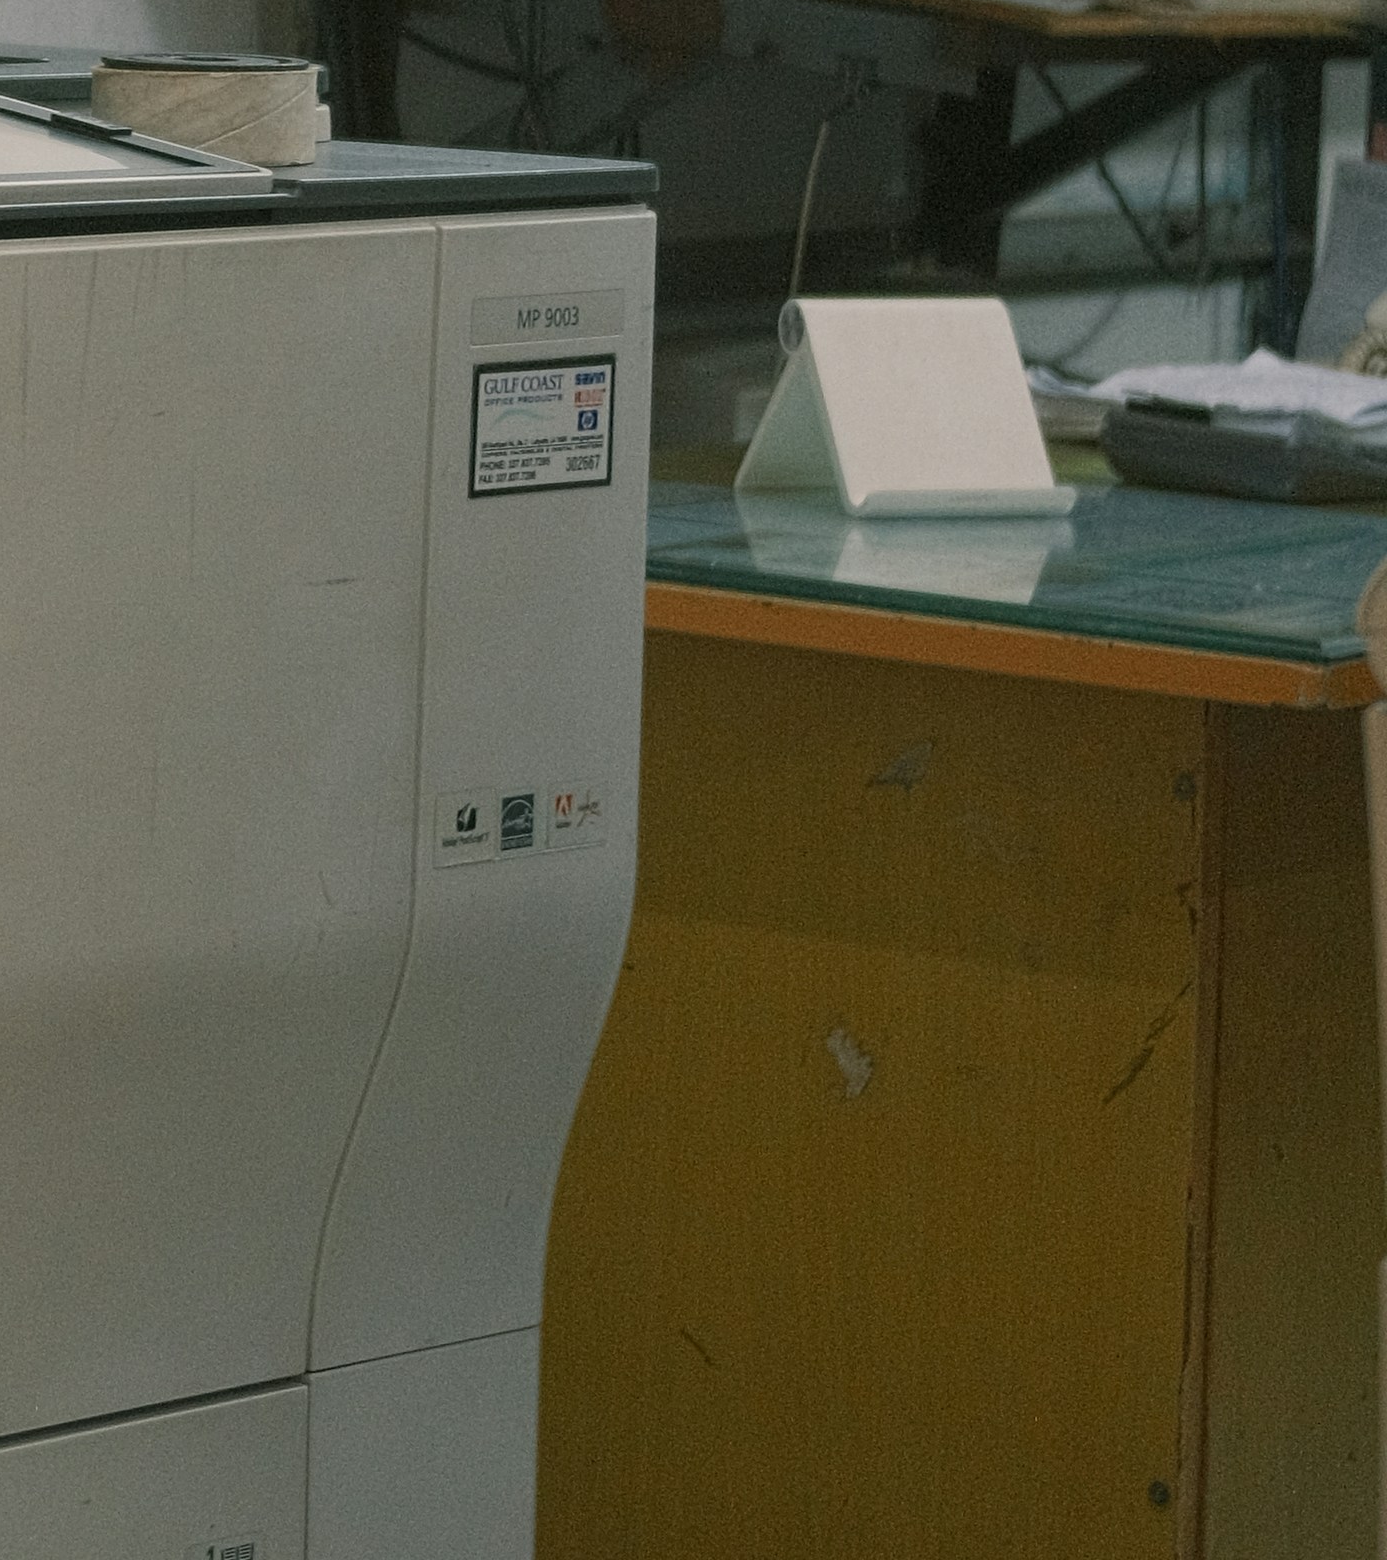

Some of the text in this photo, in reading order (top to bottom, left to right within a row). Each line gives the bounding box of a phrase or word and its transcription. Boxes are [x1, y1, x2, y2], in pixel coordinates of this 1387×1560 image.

[517, 306, 580, 329] MP 9003
[484, 374, 564, 394] GULF COAST
